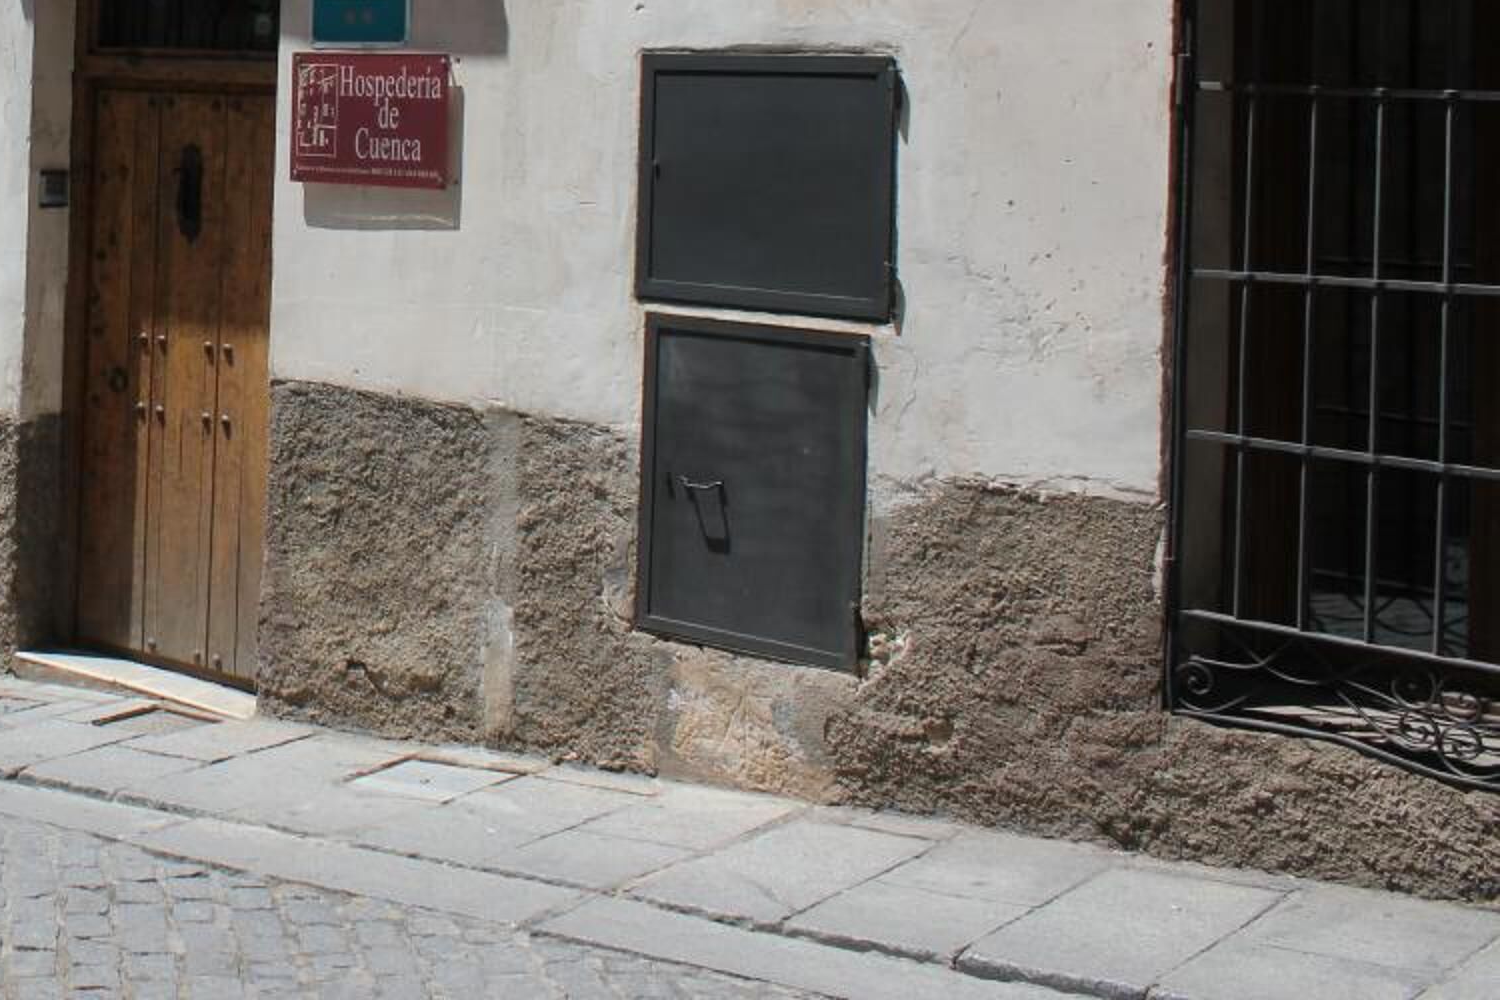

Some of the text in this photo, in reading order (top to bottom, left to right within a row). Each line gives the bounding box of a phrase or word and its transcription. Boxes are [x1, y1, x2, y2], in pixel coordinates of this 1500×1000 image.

[339, 65, 442, 106] Hospedería
[377, 98, 400, 129] de
[355, 127, 422, 161] Cuenca
